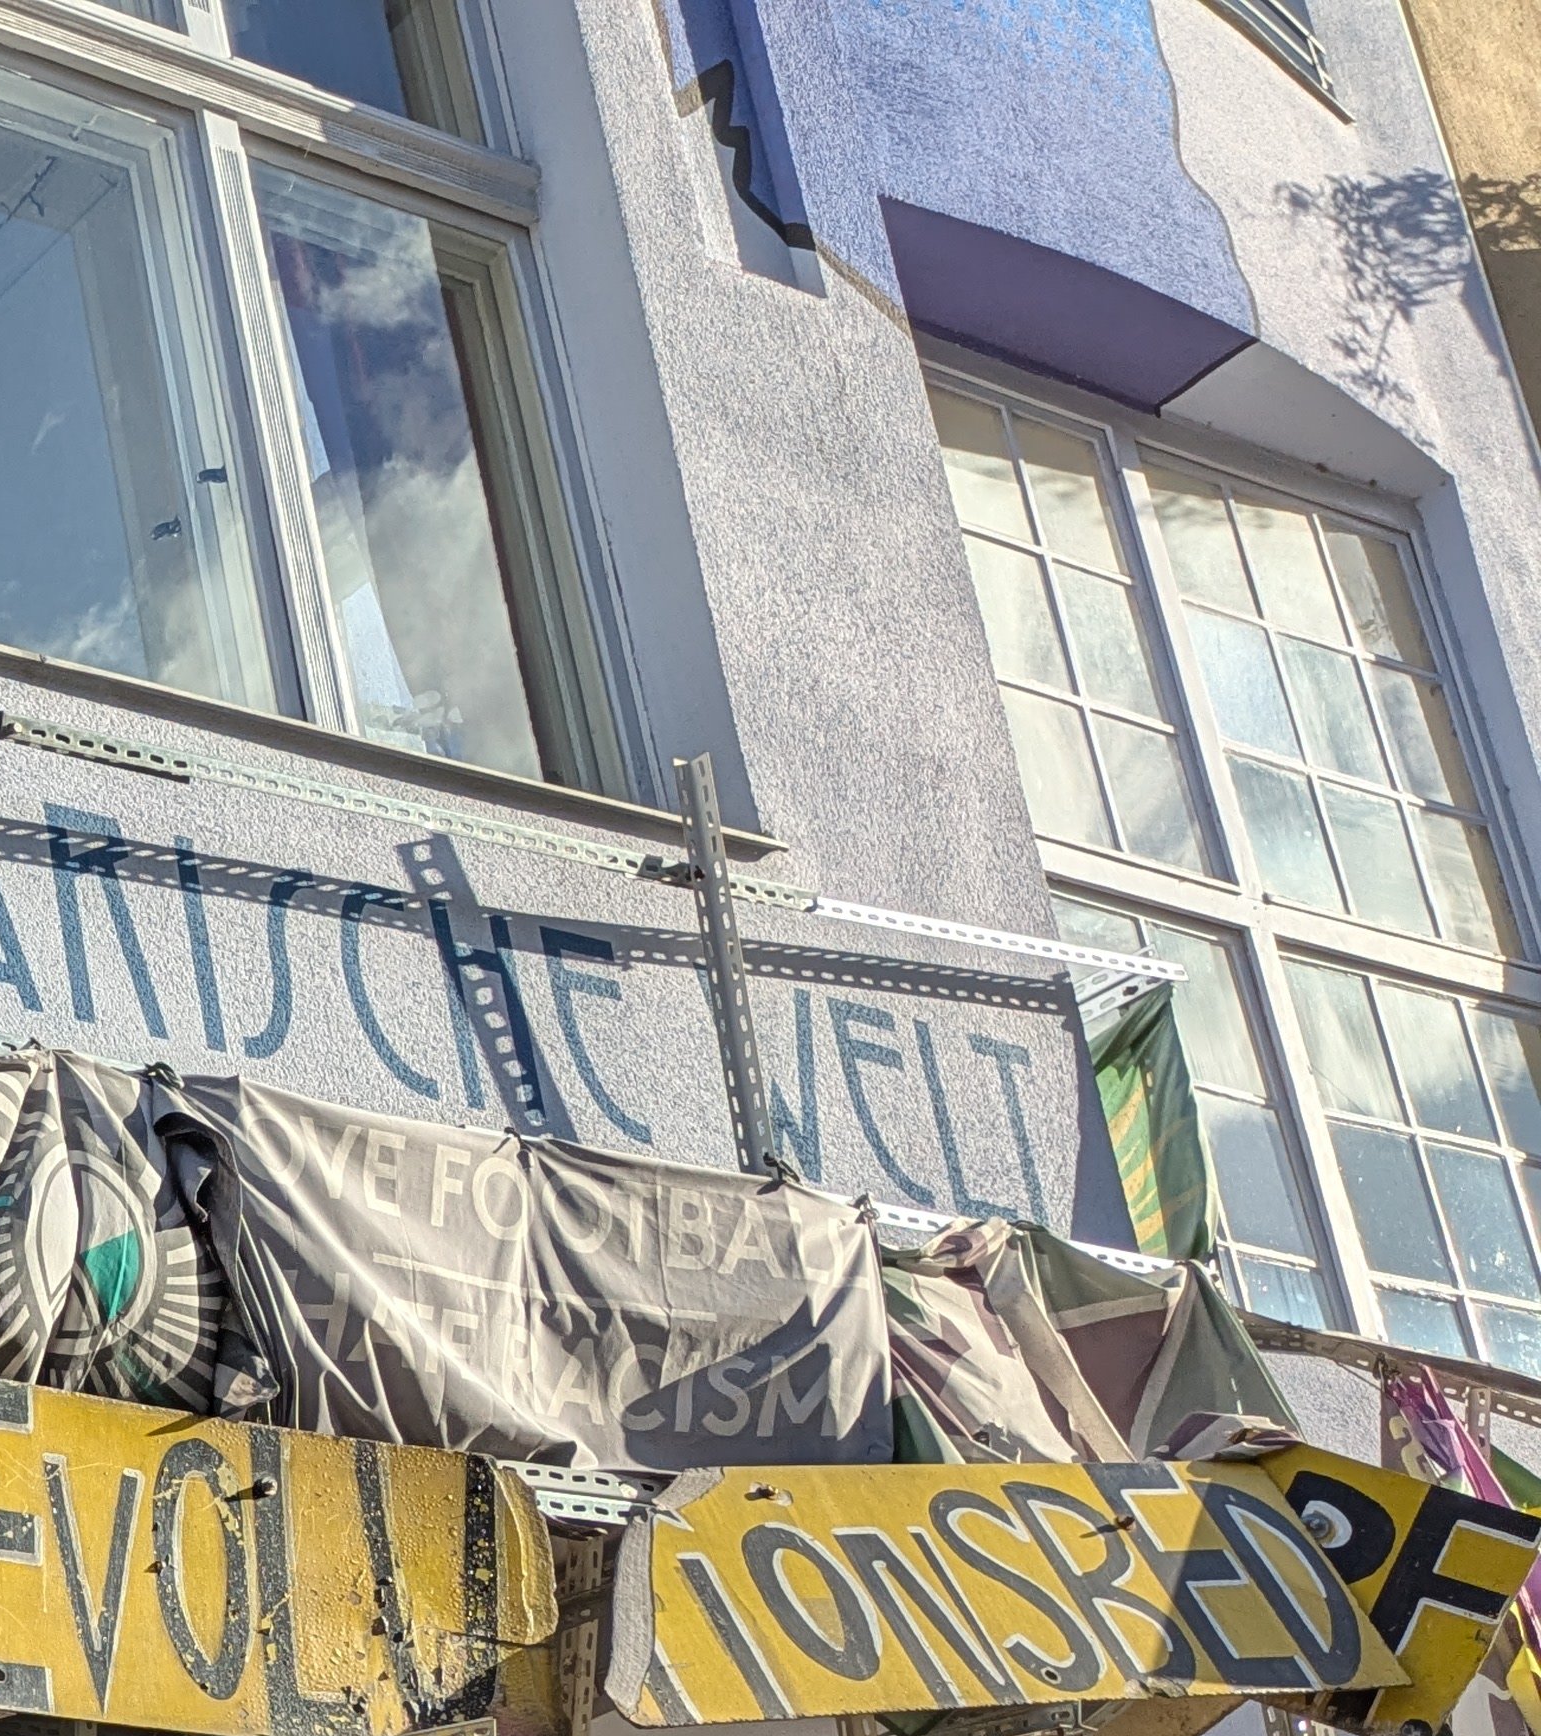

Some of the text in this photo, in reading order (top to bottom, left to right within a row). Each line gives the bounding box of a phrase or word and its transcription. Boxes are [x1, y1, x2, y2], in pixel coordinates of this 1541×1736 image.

[237, 1106, 868, 1290] OVE FOOTBALL
[502, 1318, 857, 1439] RACISM
